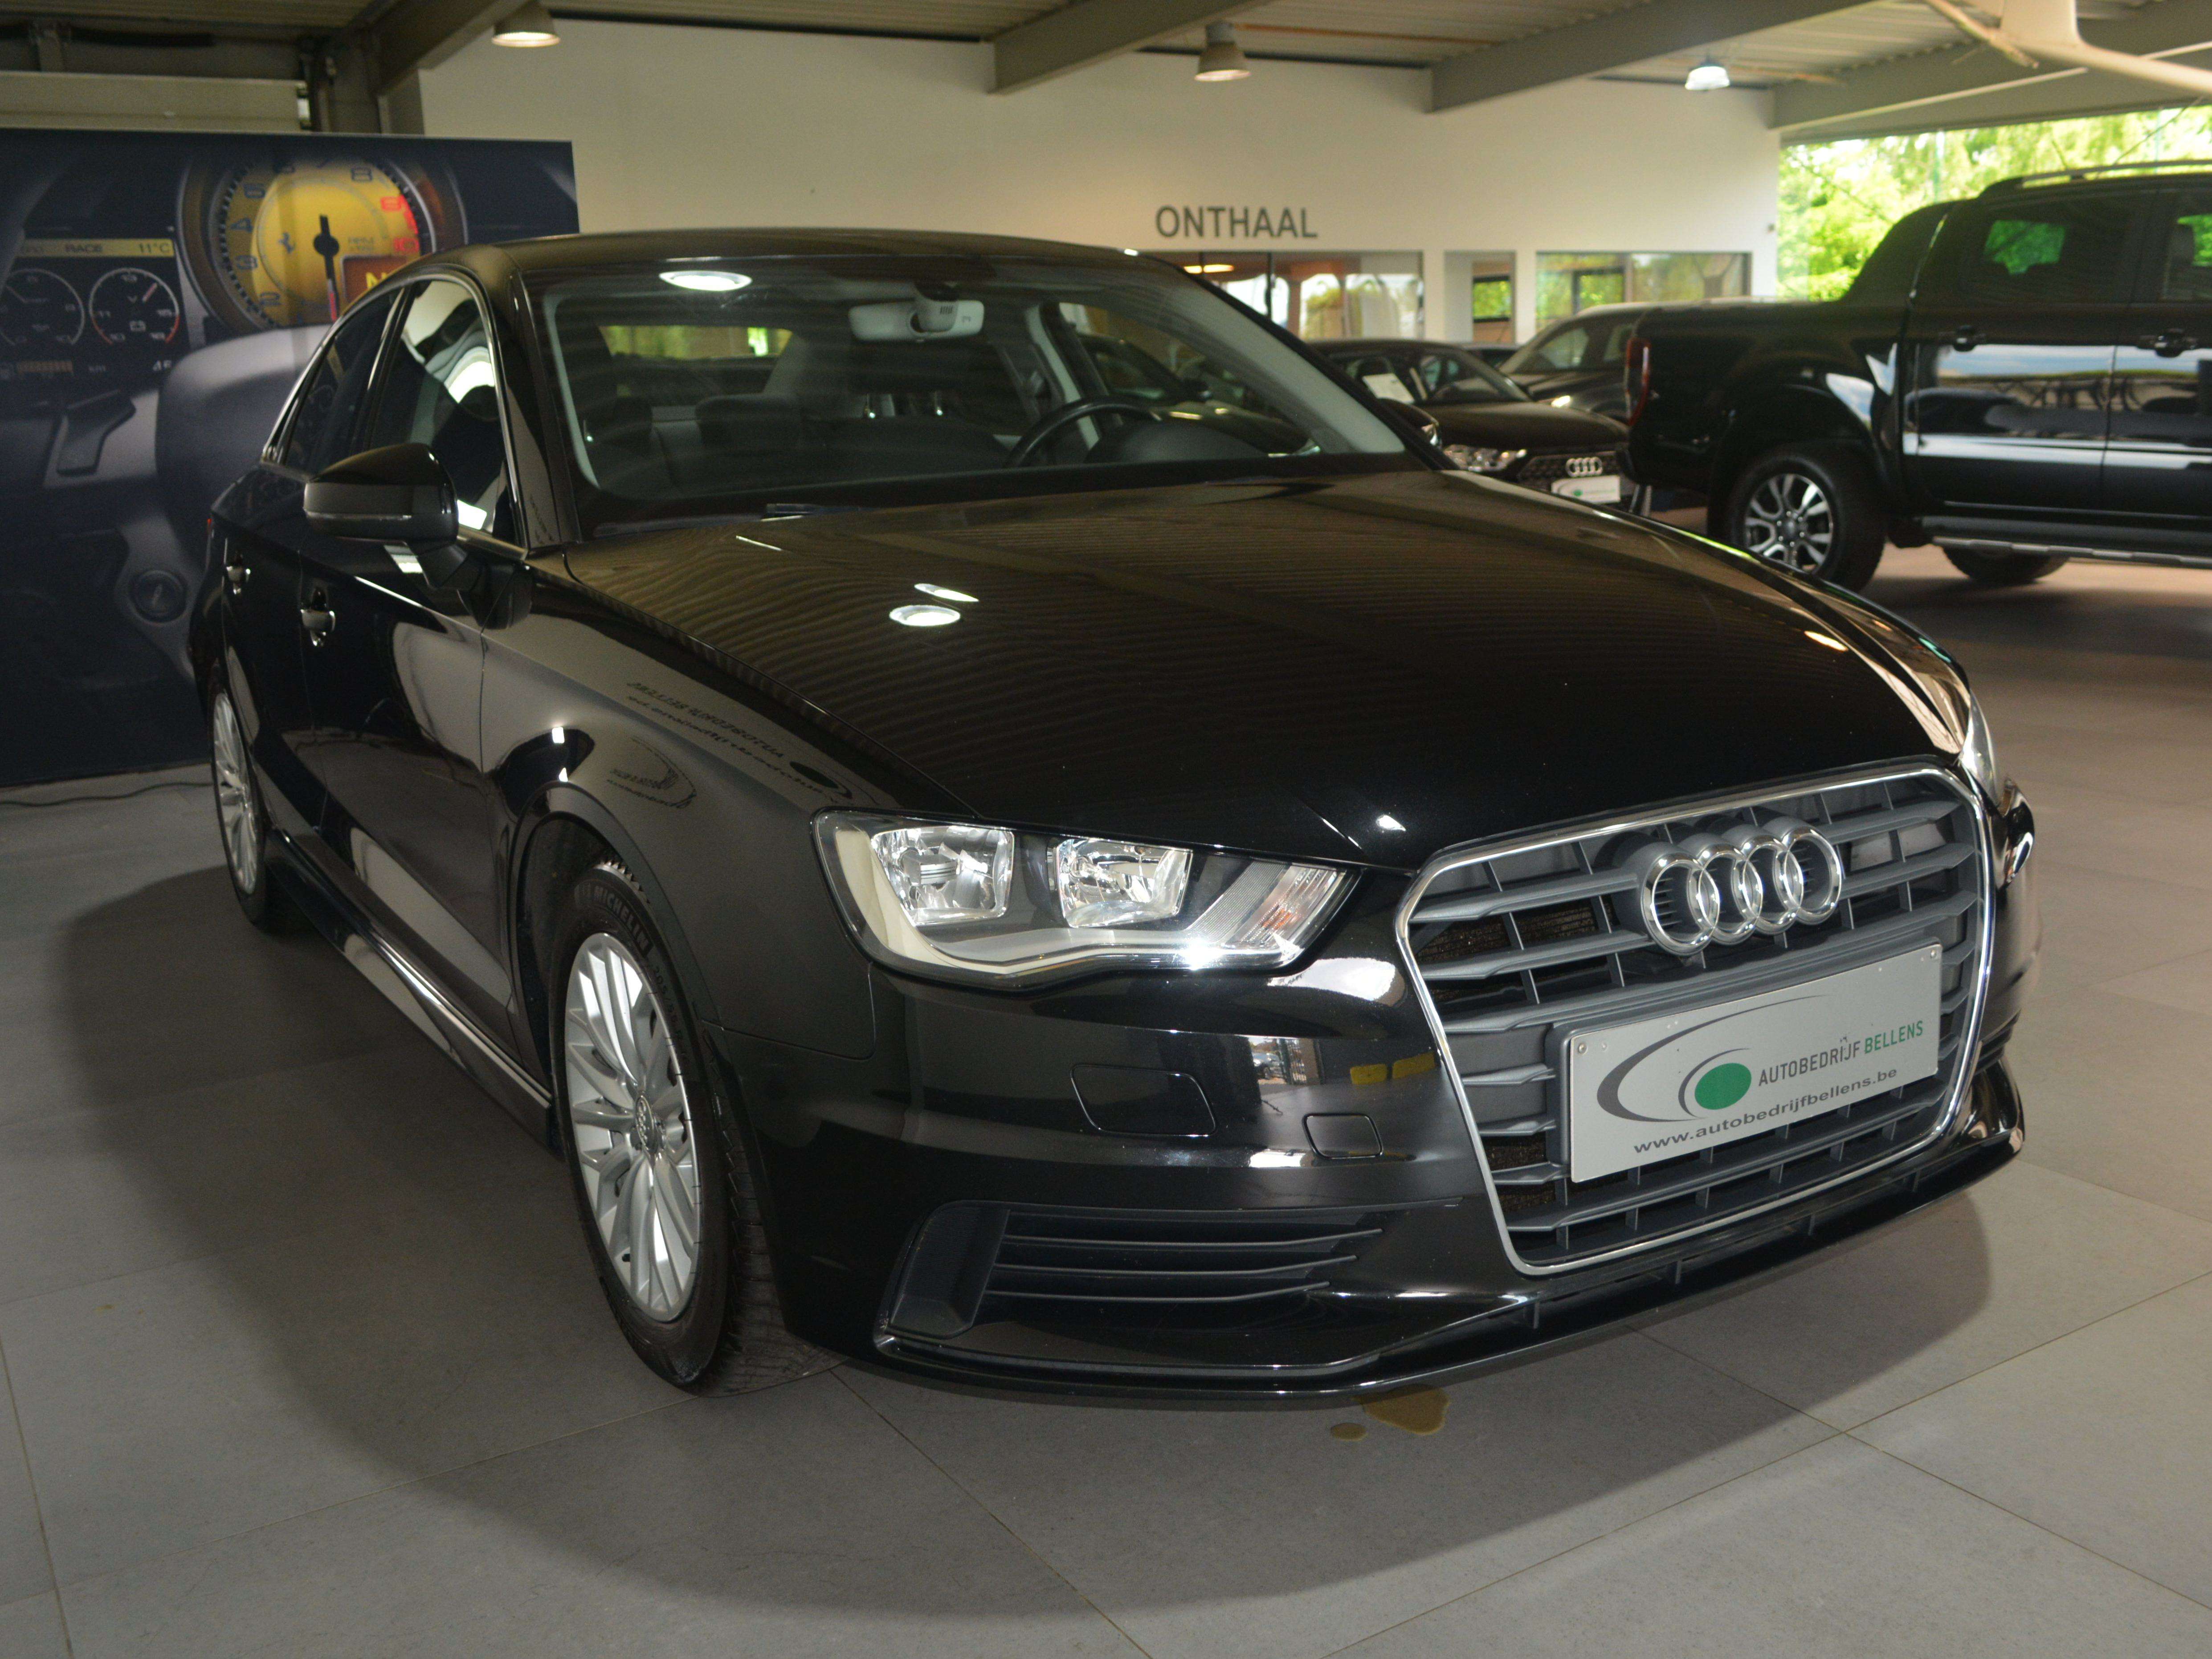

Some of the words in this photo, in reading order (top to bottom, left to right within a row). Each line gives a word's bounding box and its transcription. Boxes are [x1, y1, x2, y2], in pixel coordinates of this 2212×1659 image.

[229, 217, 253, 233] 4
[1155, 205, 1318, 238] ONTHAAL
[236, 254, 258, 270] 3
[594, 885, 649, 951] MICHELIN
[1758, 1040, 1861, 1086] AUTOBEDRIJF
[1864, 1020, 1923, 1055] BELLENS
[1633, 1068, 1898, 1153] www.autobedrijfbellens.be
